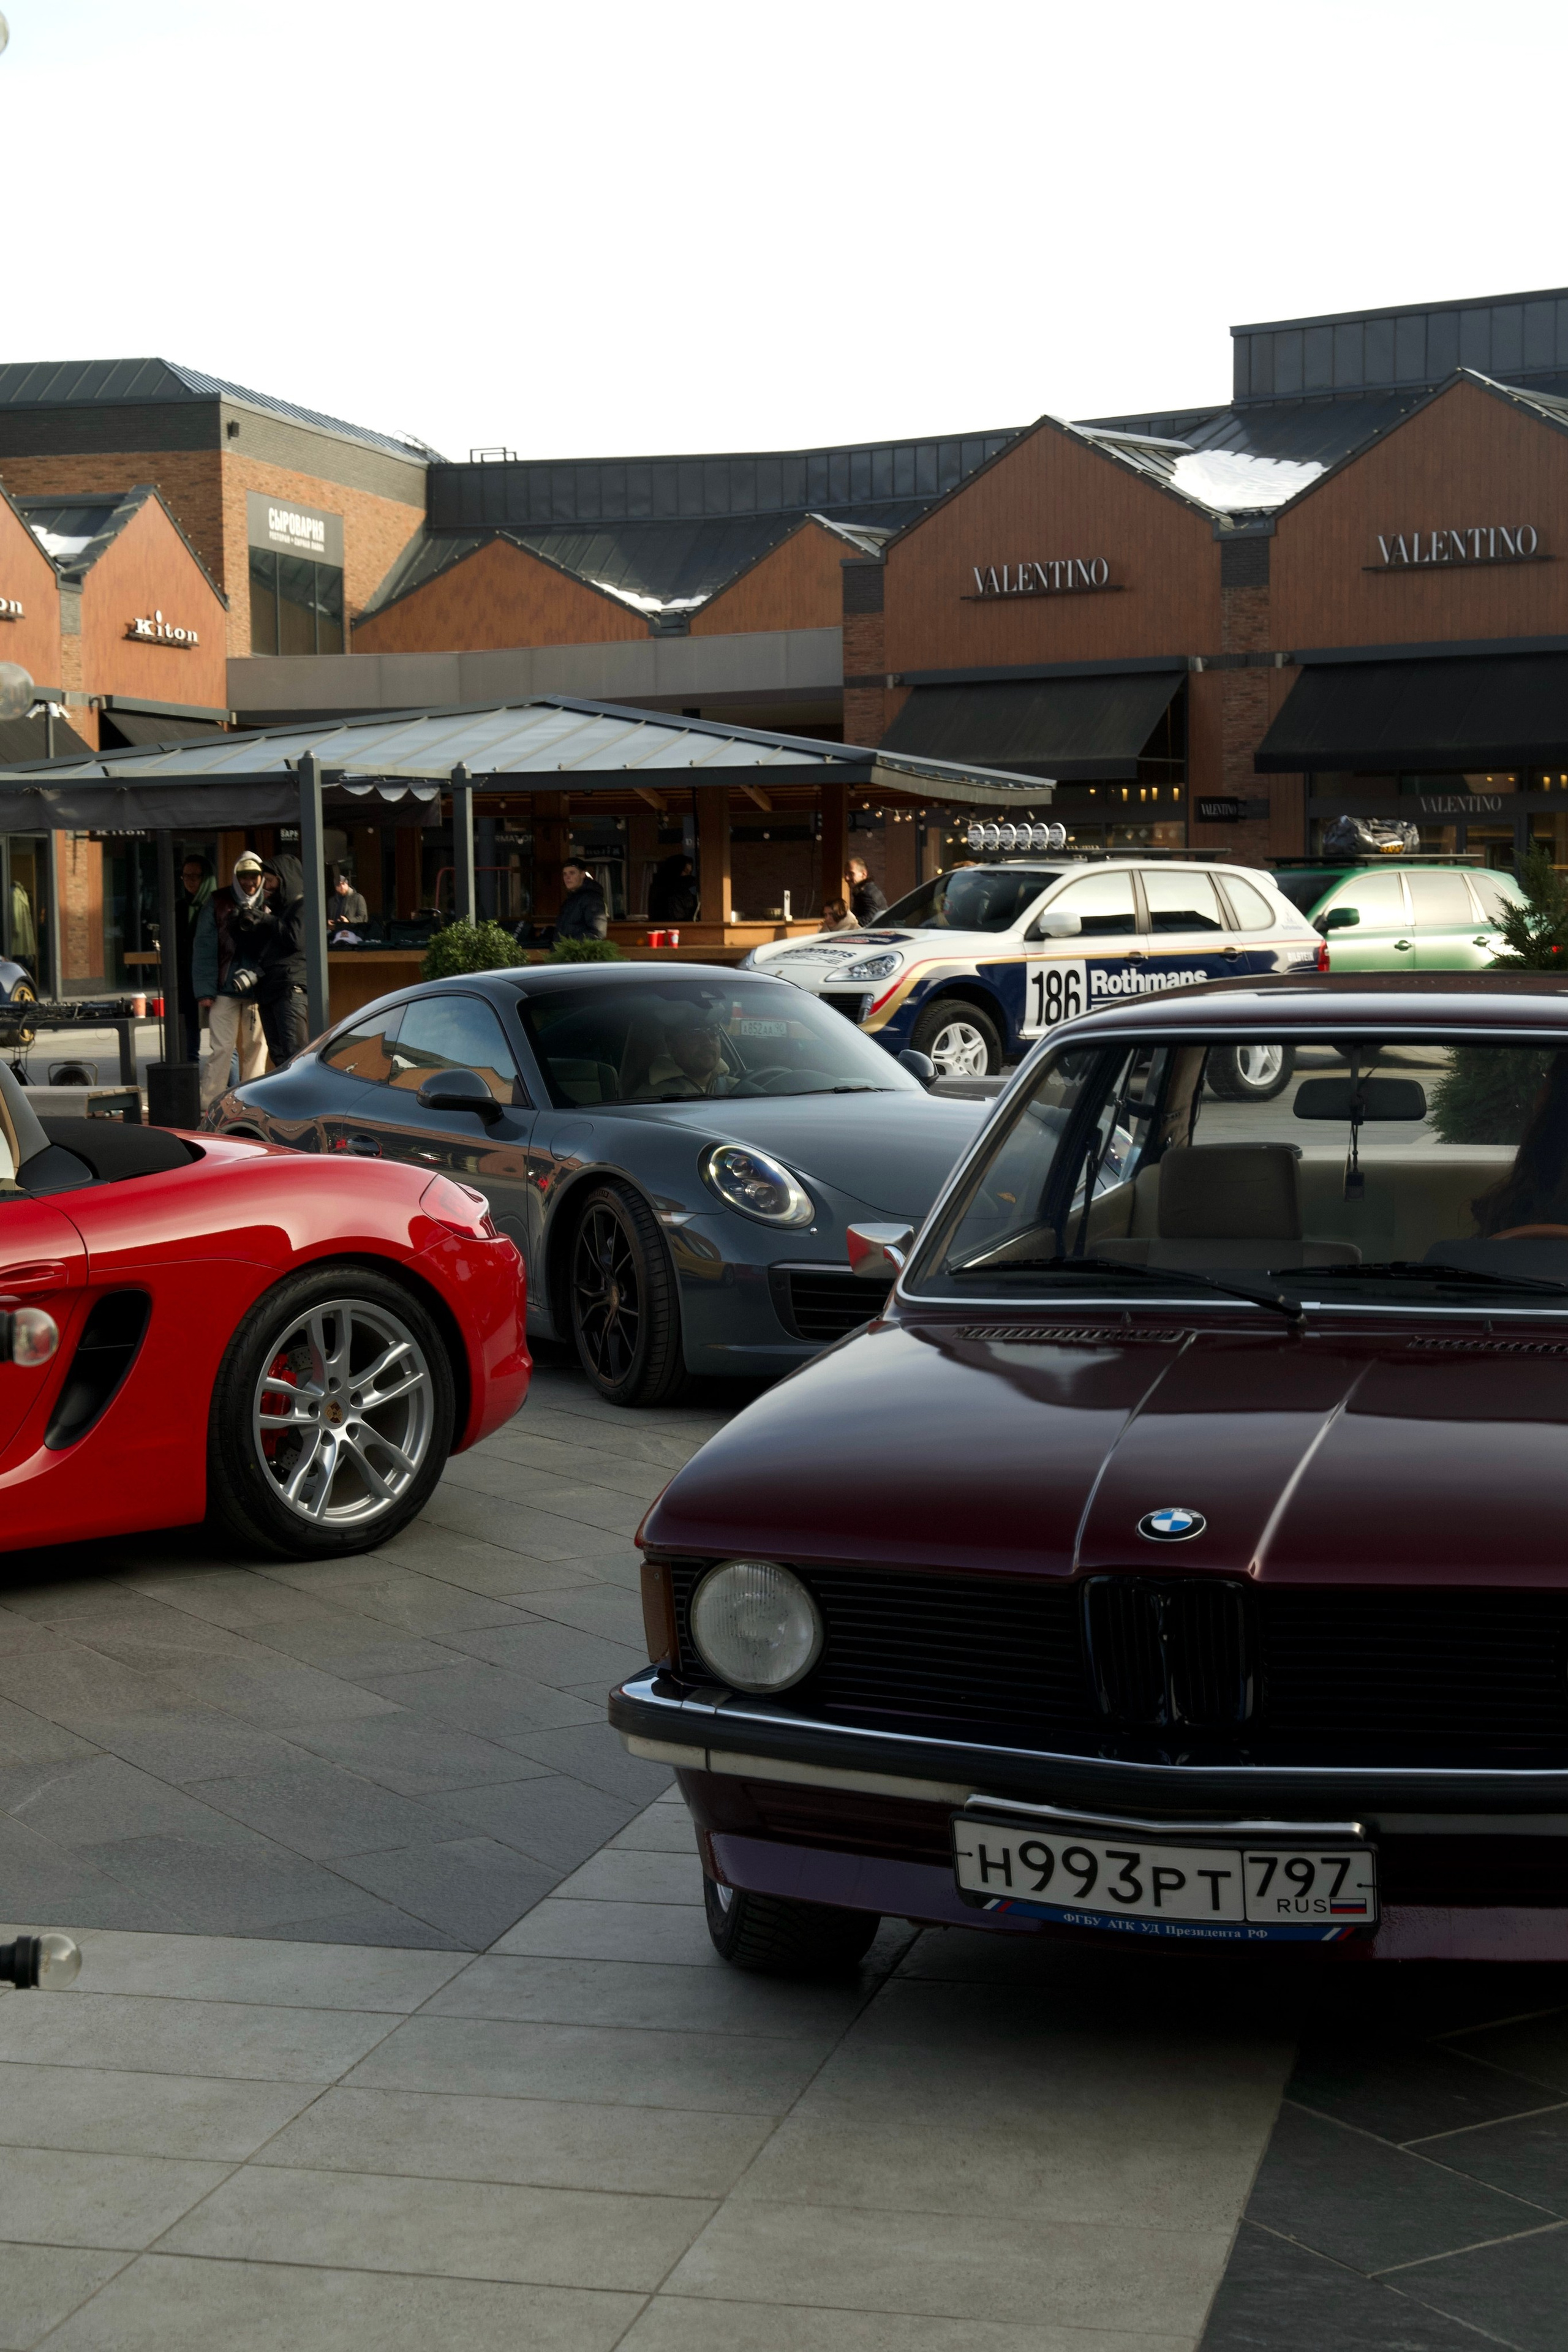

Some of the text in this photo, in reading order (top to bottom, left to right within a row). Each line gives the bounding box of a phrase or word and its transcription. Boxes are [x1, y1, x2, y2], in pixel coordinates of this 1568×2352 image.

[268, 507, 324, 543] СЫРОВАРНЯ
[1378, 524, 1538, 565] VALENTINO
[973, 557, 1109, 594] VALENTINO
[134, 610, 198, 643] Kiton
[1420, 796, 1502, 812] VALENTINO
[1031, 970, 1080, 1026] 186
[1090, 968, 1208, 995] Rothmans
[1150, 1509, 1202, 1518] BMW
[978, 1840, 1351, 1911] Н993РТ 797
[1277, 1899, 1327, 1913] RUS
[1063, 1913, 1268, 1939] ФГБУ АТК УД Президента РФ
